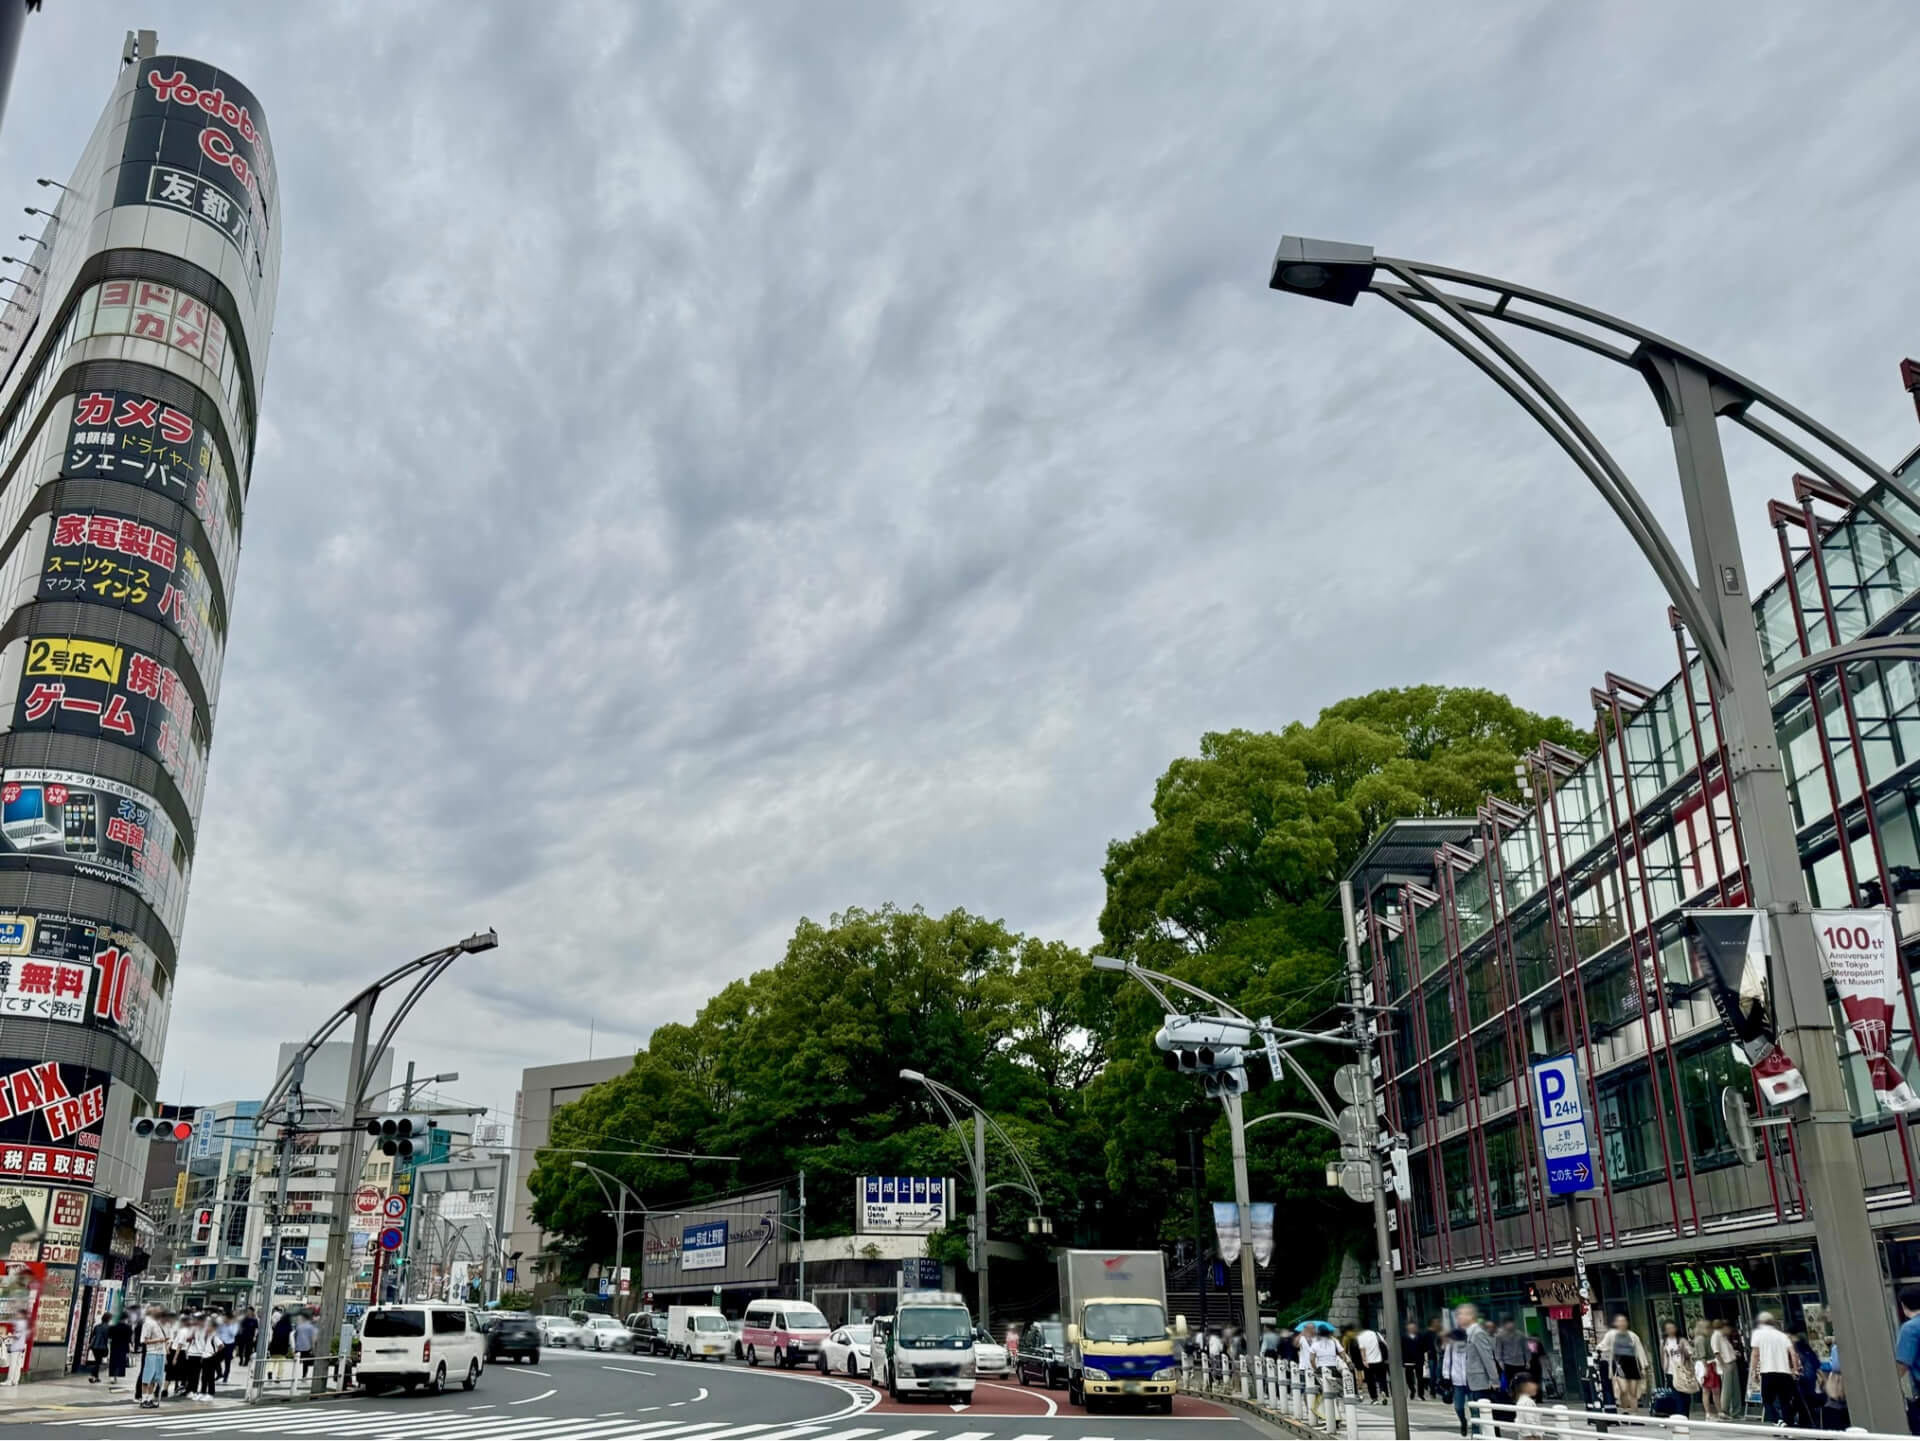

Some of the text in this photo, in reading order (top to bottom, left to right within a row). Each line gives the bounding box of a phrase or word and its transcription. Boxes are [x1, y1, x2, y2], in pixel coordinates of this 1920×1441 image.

[75, 392, 193, 444] カメラ
[121, 433, 193, 471] ドライヤー
[71, 449, 187, 488] シェーバー
[53, 514, 177, 572] 家電製品
[45, 577, 87, 592] マウス
[47, 557, 151, 588] スーツケース
[92, 578, 149, 604] インク
[28, 641, 113, 677] 2号店へ
[25, 682, 136, 736] ゲーム
[106, 817, 146, 852] 店舗
[1829, 951, 1878, 961] Anniversary
[1845, 961, 1869, 970] Tokyo
[18, 963, 84, 999] 無料
[1832, 969, 1885, 978] Metropolitan
[1848, 977, 1885, 985] Museum
[1538, 1068, 1566, 1119] P
[43, 1084, 104, 1141] FREE
[1554, 1100, 1579, 1117] 24H
[1557, 1130, 1571, 1142] 上野
[4, 1150, 96, 1177] 税品取扱店
[1551, 1169, 1573, 1182] この先
[867, 1182, 942, 1194] 京成上野駅
